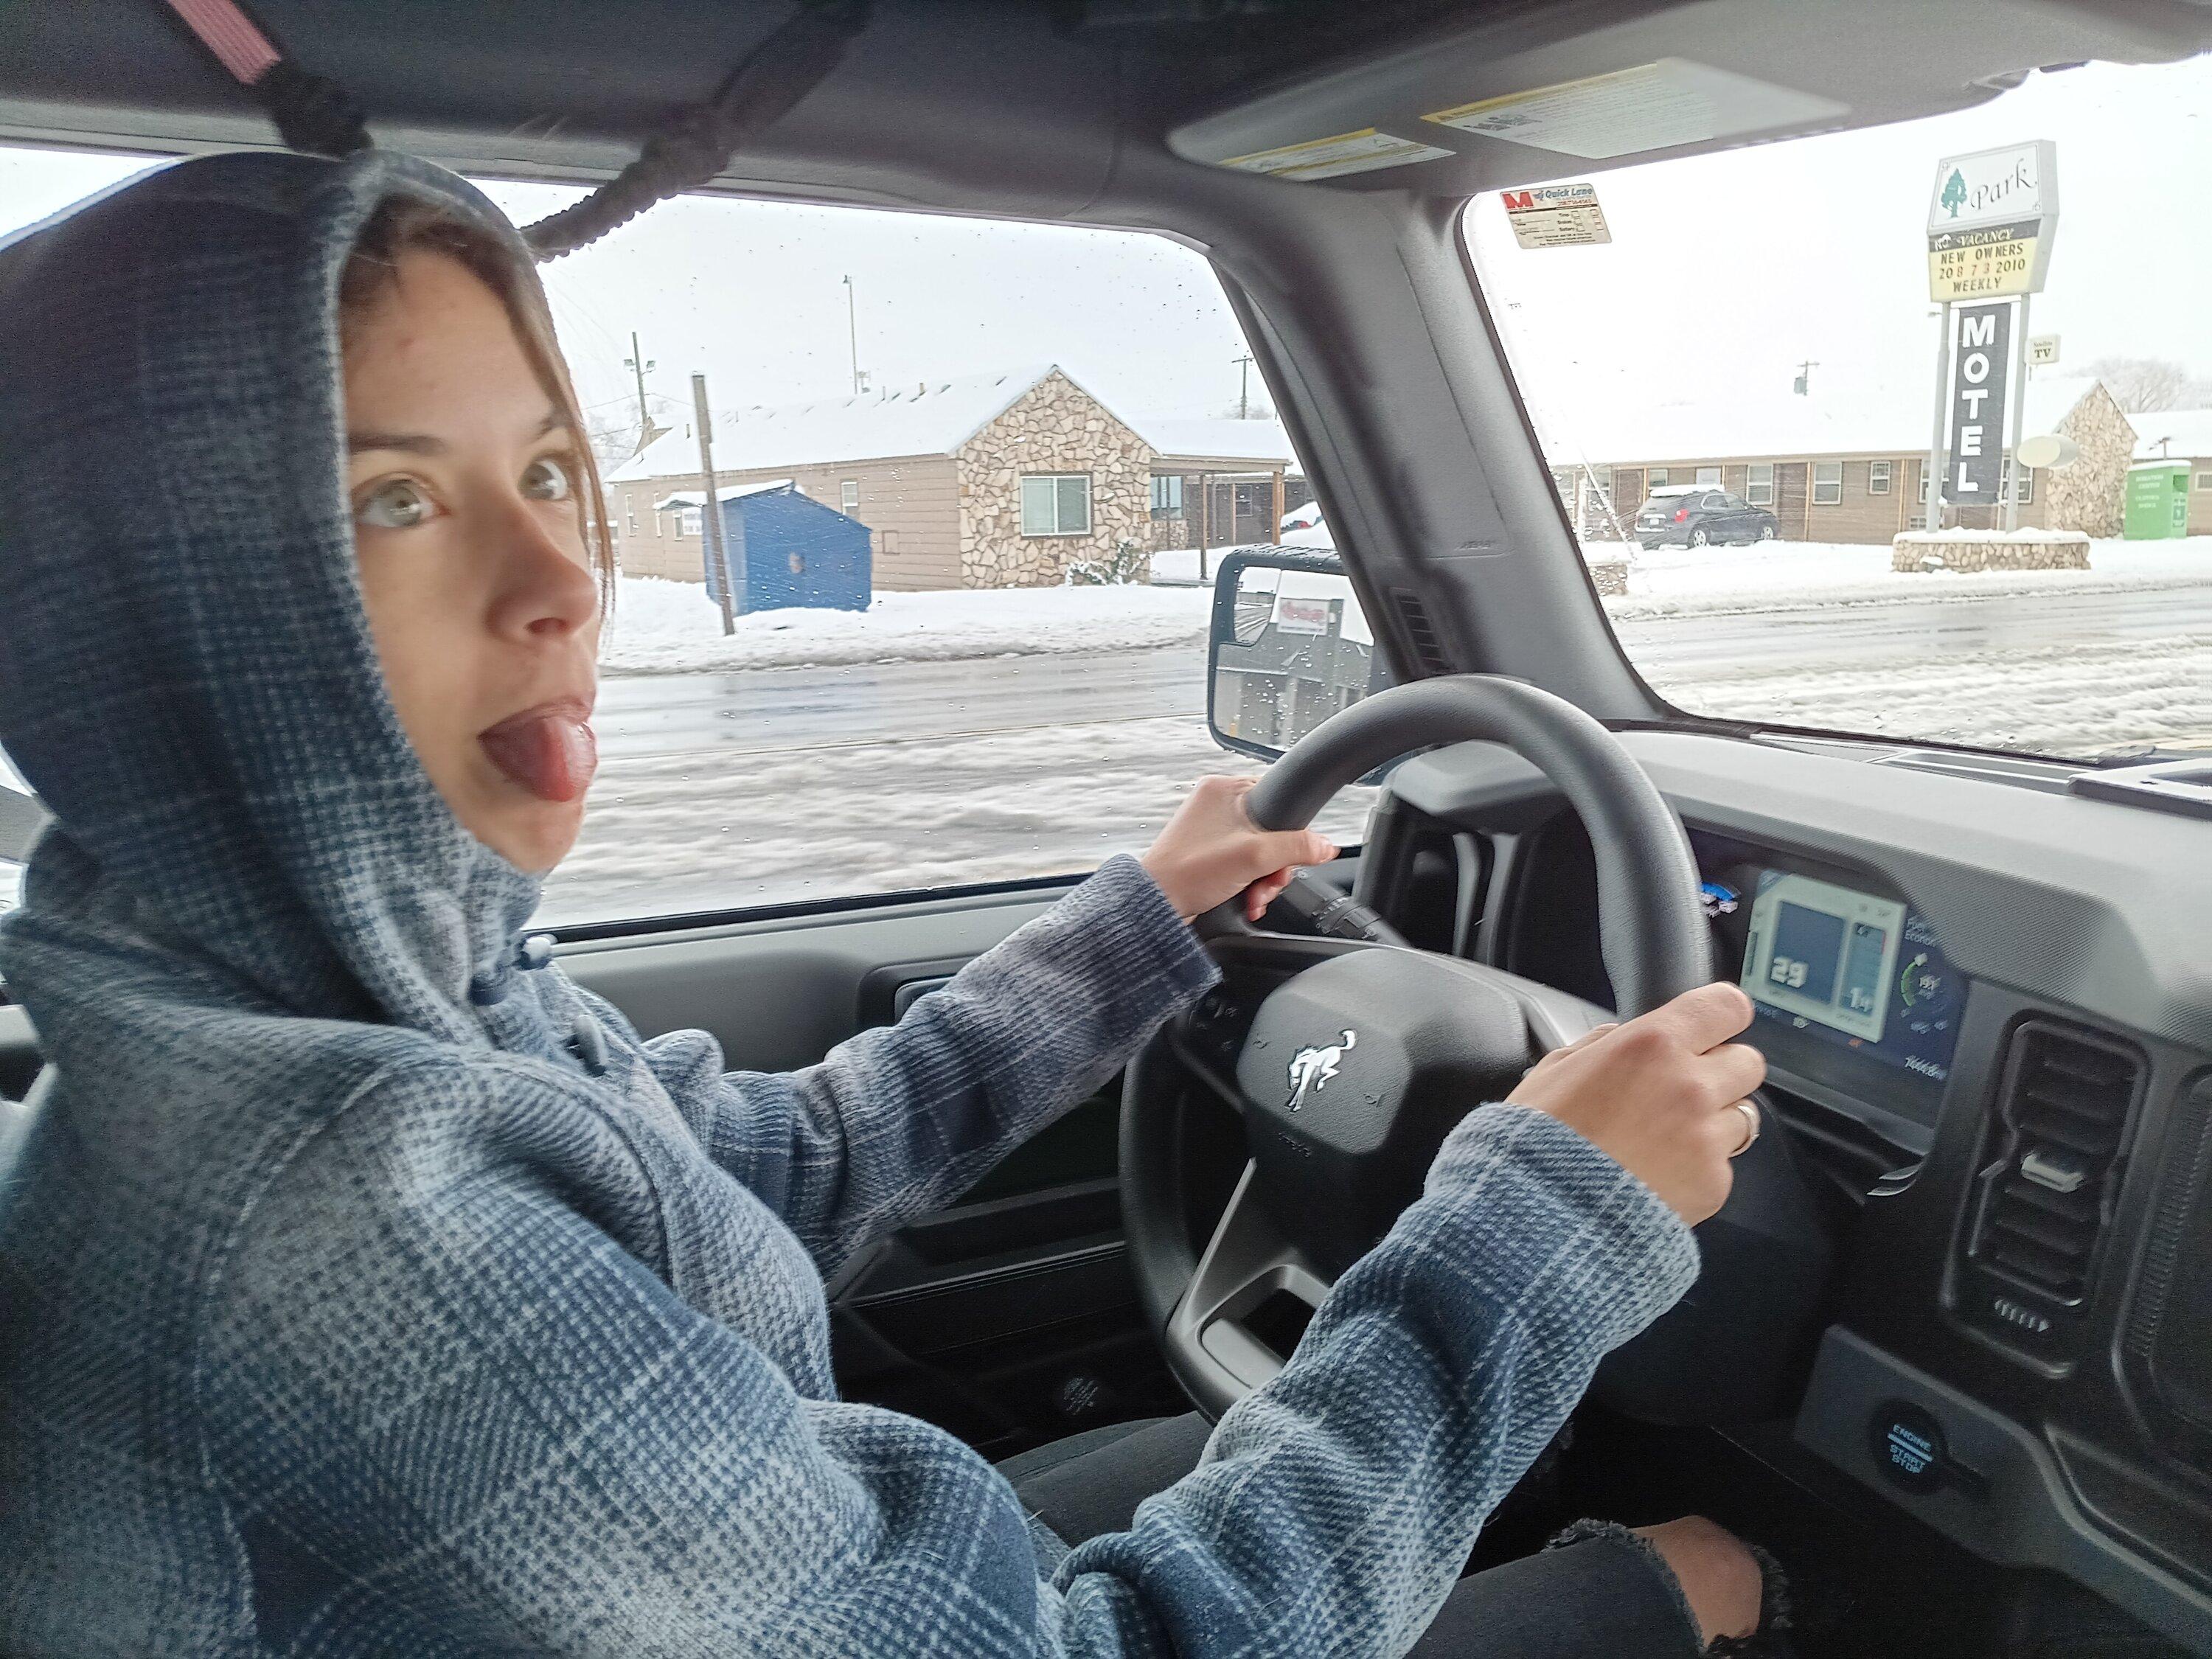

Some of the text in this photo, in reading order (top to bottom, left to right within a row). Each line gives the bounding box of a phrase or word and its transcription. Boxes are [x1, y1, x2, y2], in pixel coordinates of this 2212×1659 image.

[1545, 189, 1570, 198] Quick
[1571, 187, 1593, 196] Lane
[1970, 158, 2037, 210] Park
[1957, 228, 2014, 247] VACANCY
[1941, 251, 1966, 265] NEW
[1996, 259, 2025, 274] 2010
[1953, 277, 2002, 293] WEEKLY
[2034, 348, 2051, 358] TV
[1958, 315, 1996, 492] MOTEL
[1770, 956, 1809, 988] 29
[1893, 1424, 1932, 1452] ENGINE
